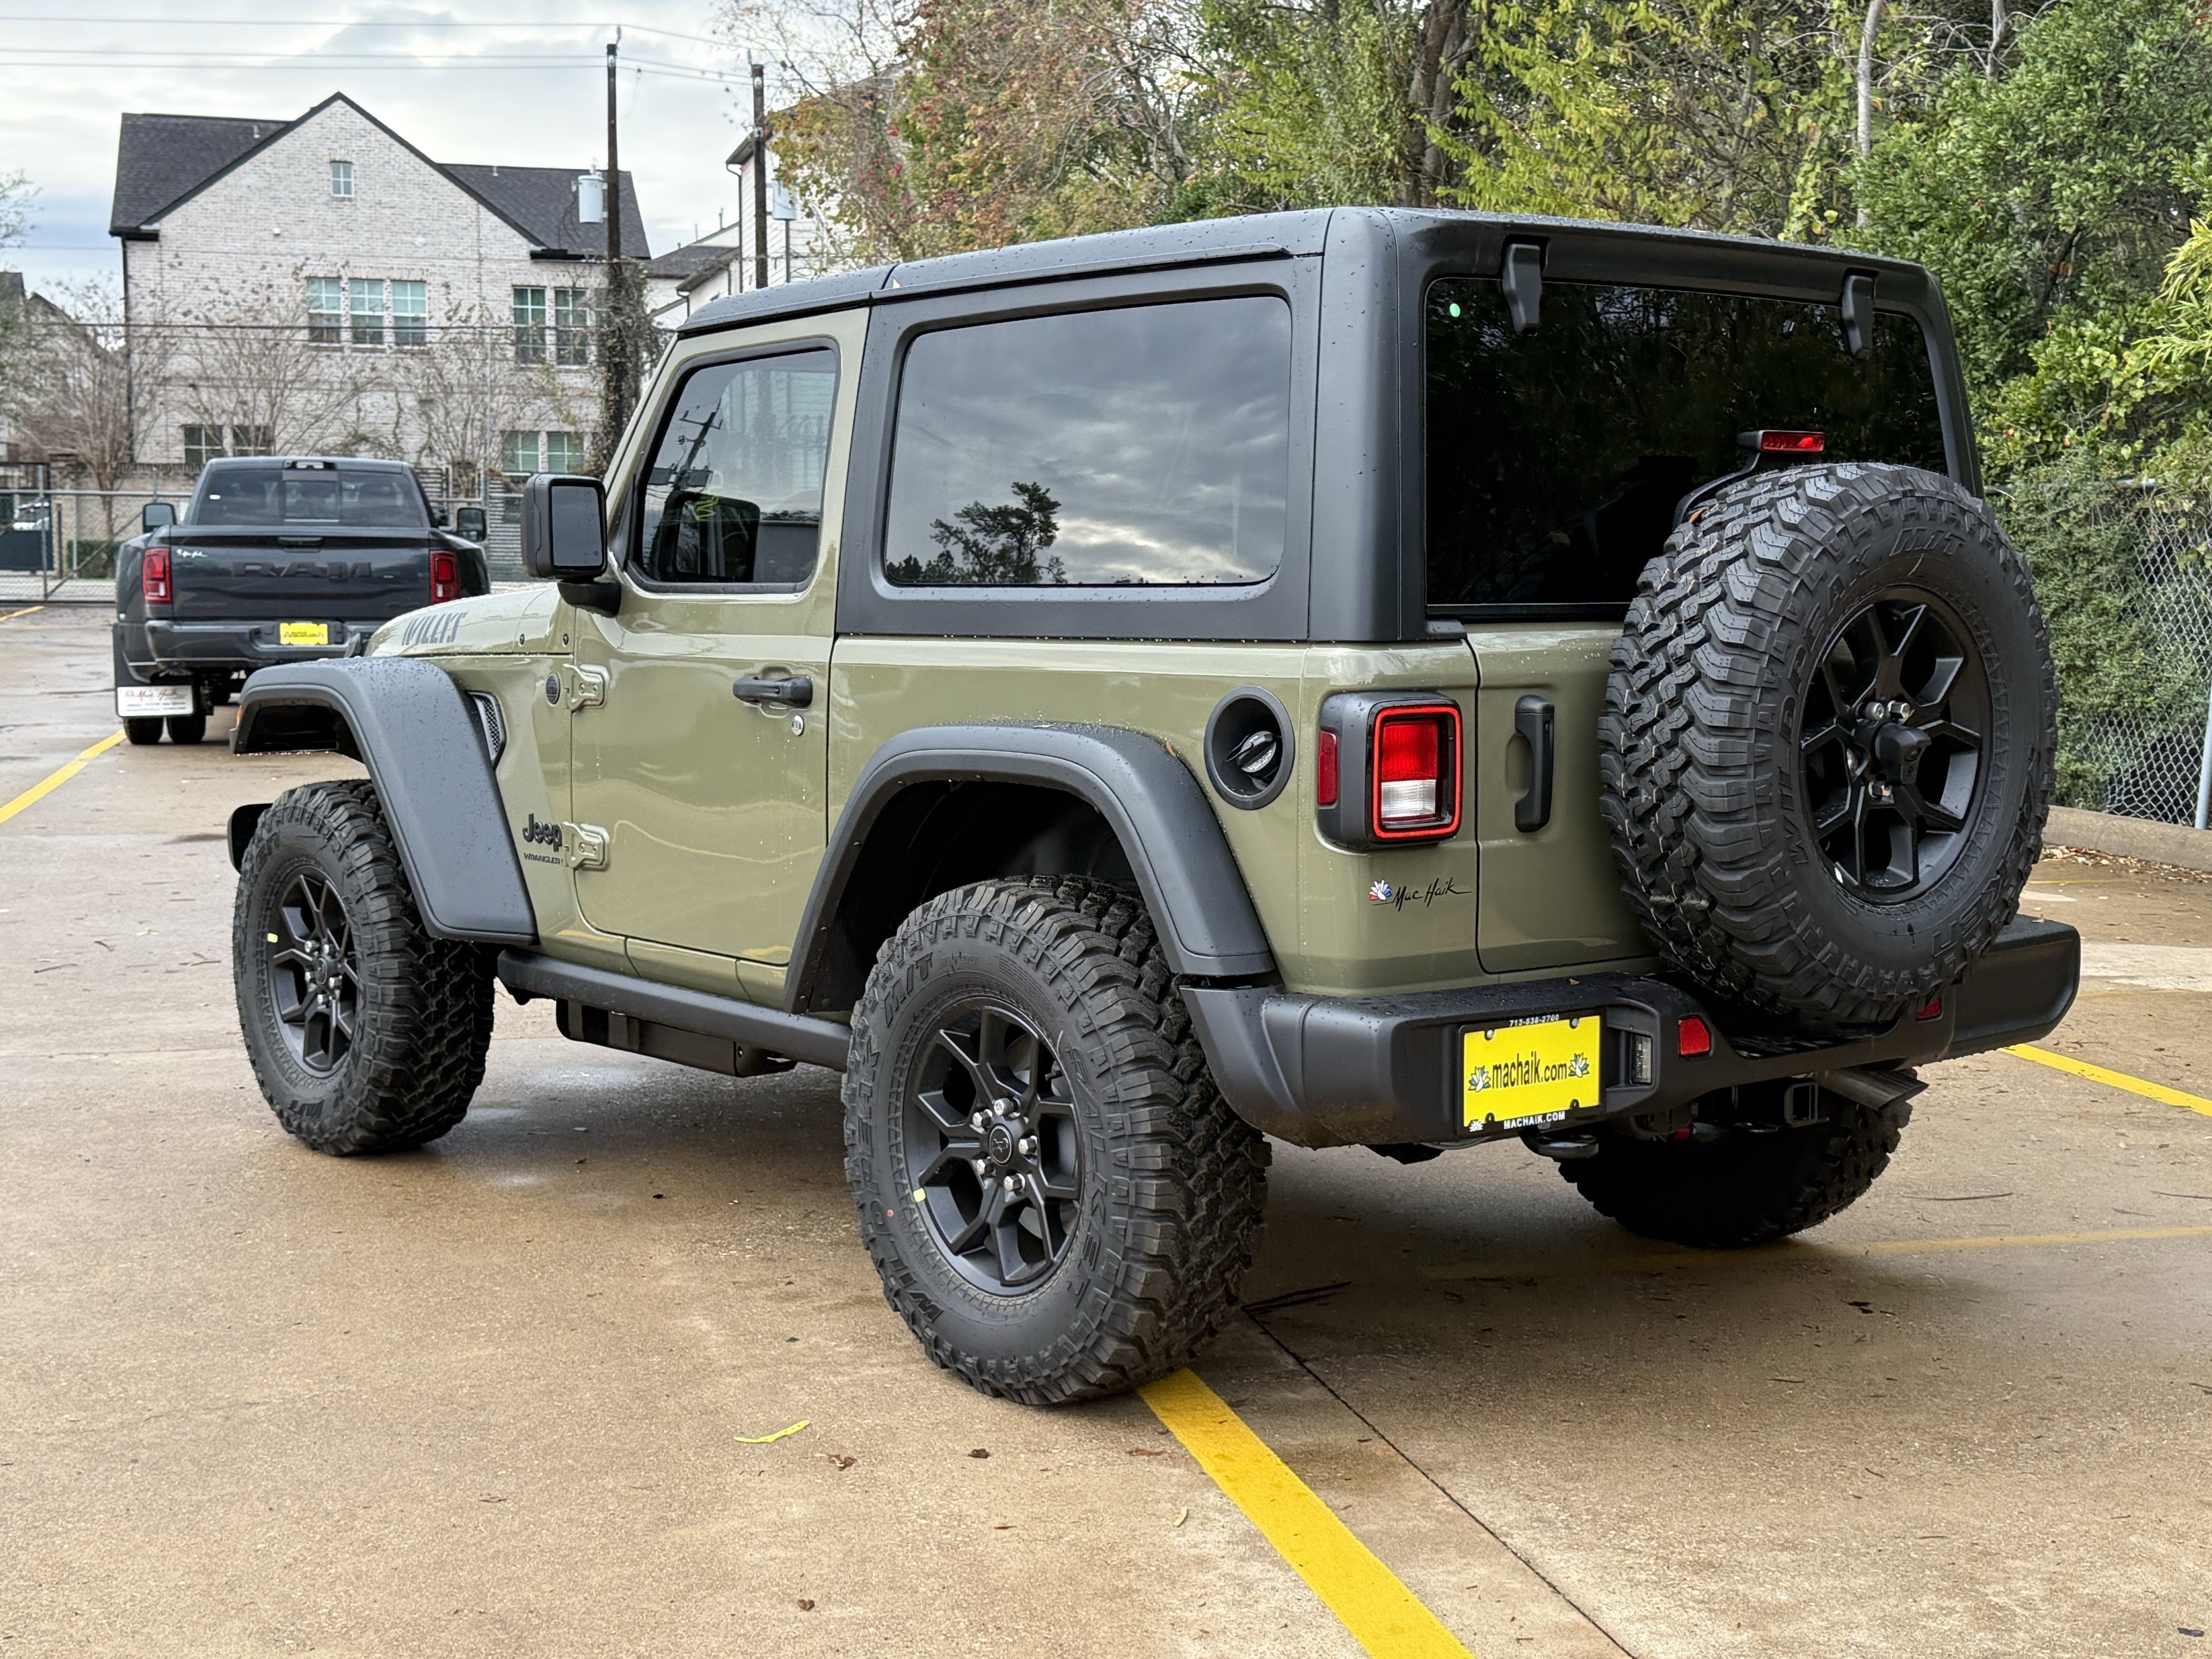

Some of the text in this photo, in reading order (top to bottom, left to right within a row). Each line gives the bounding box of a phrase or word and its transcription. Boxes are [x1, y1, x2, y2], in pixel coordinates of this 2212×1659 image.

[233, 562, 372, 577] RAM
[401, 611, 468, 646] WILLYS
[523, 813, 562, 852] Jeep
[523, 852, 560, 866] WRANGLER
[1372, 877, 1472, 912] Mac Haik
[1492, 1051, 1567, 1089] machaik.com
[1503, 1111, 1566, 1130] MACHAIK.COM
